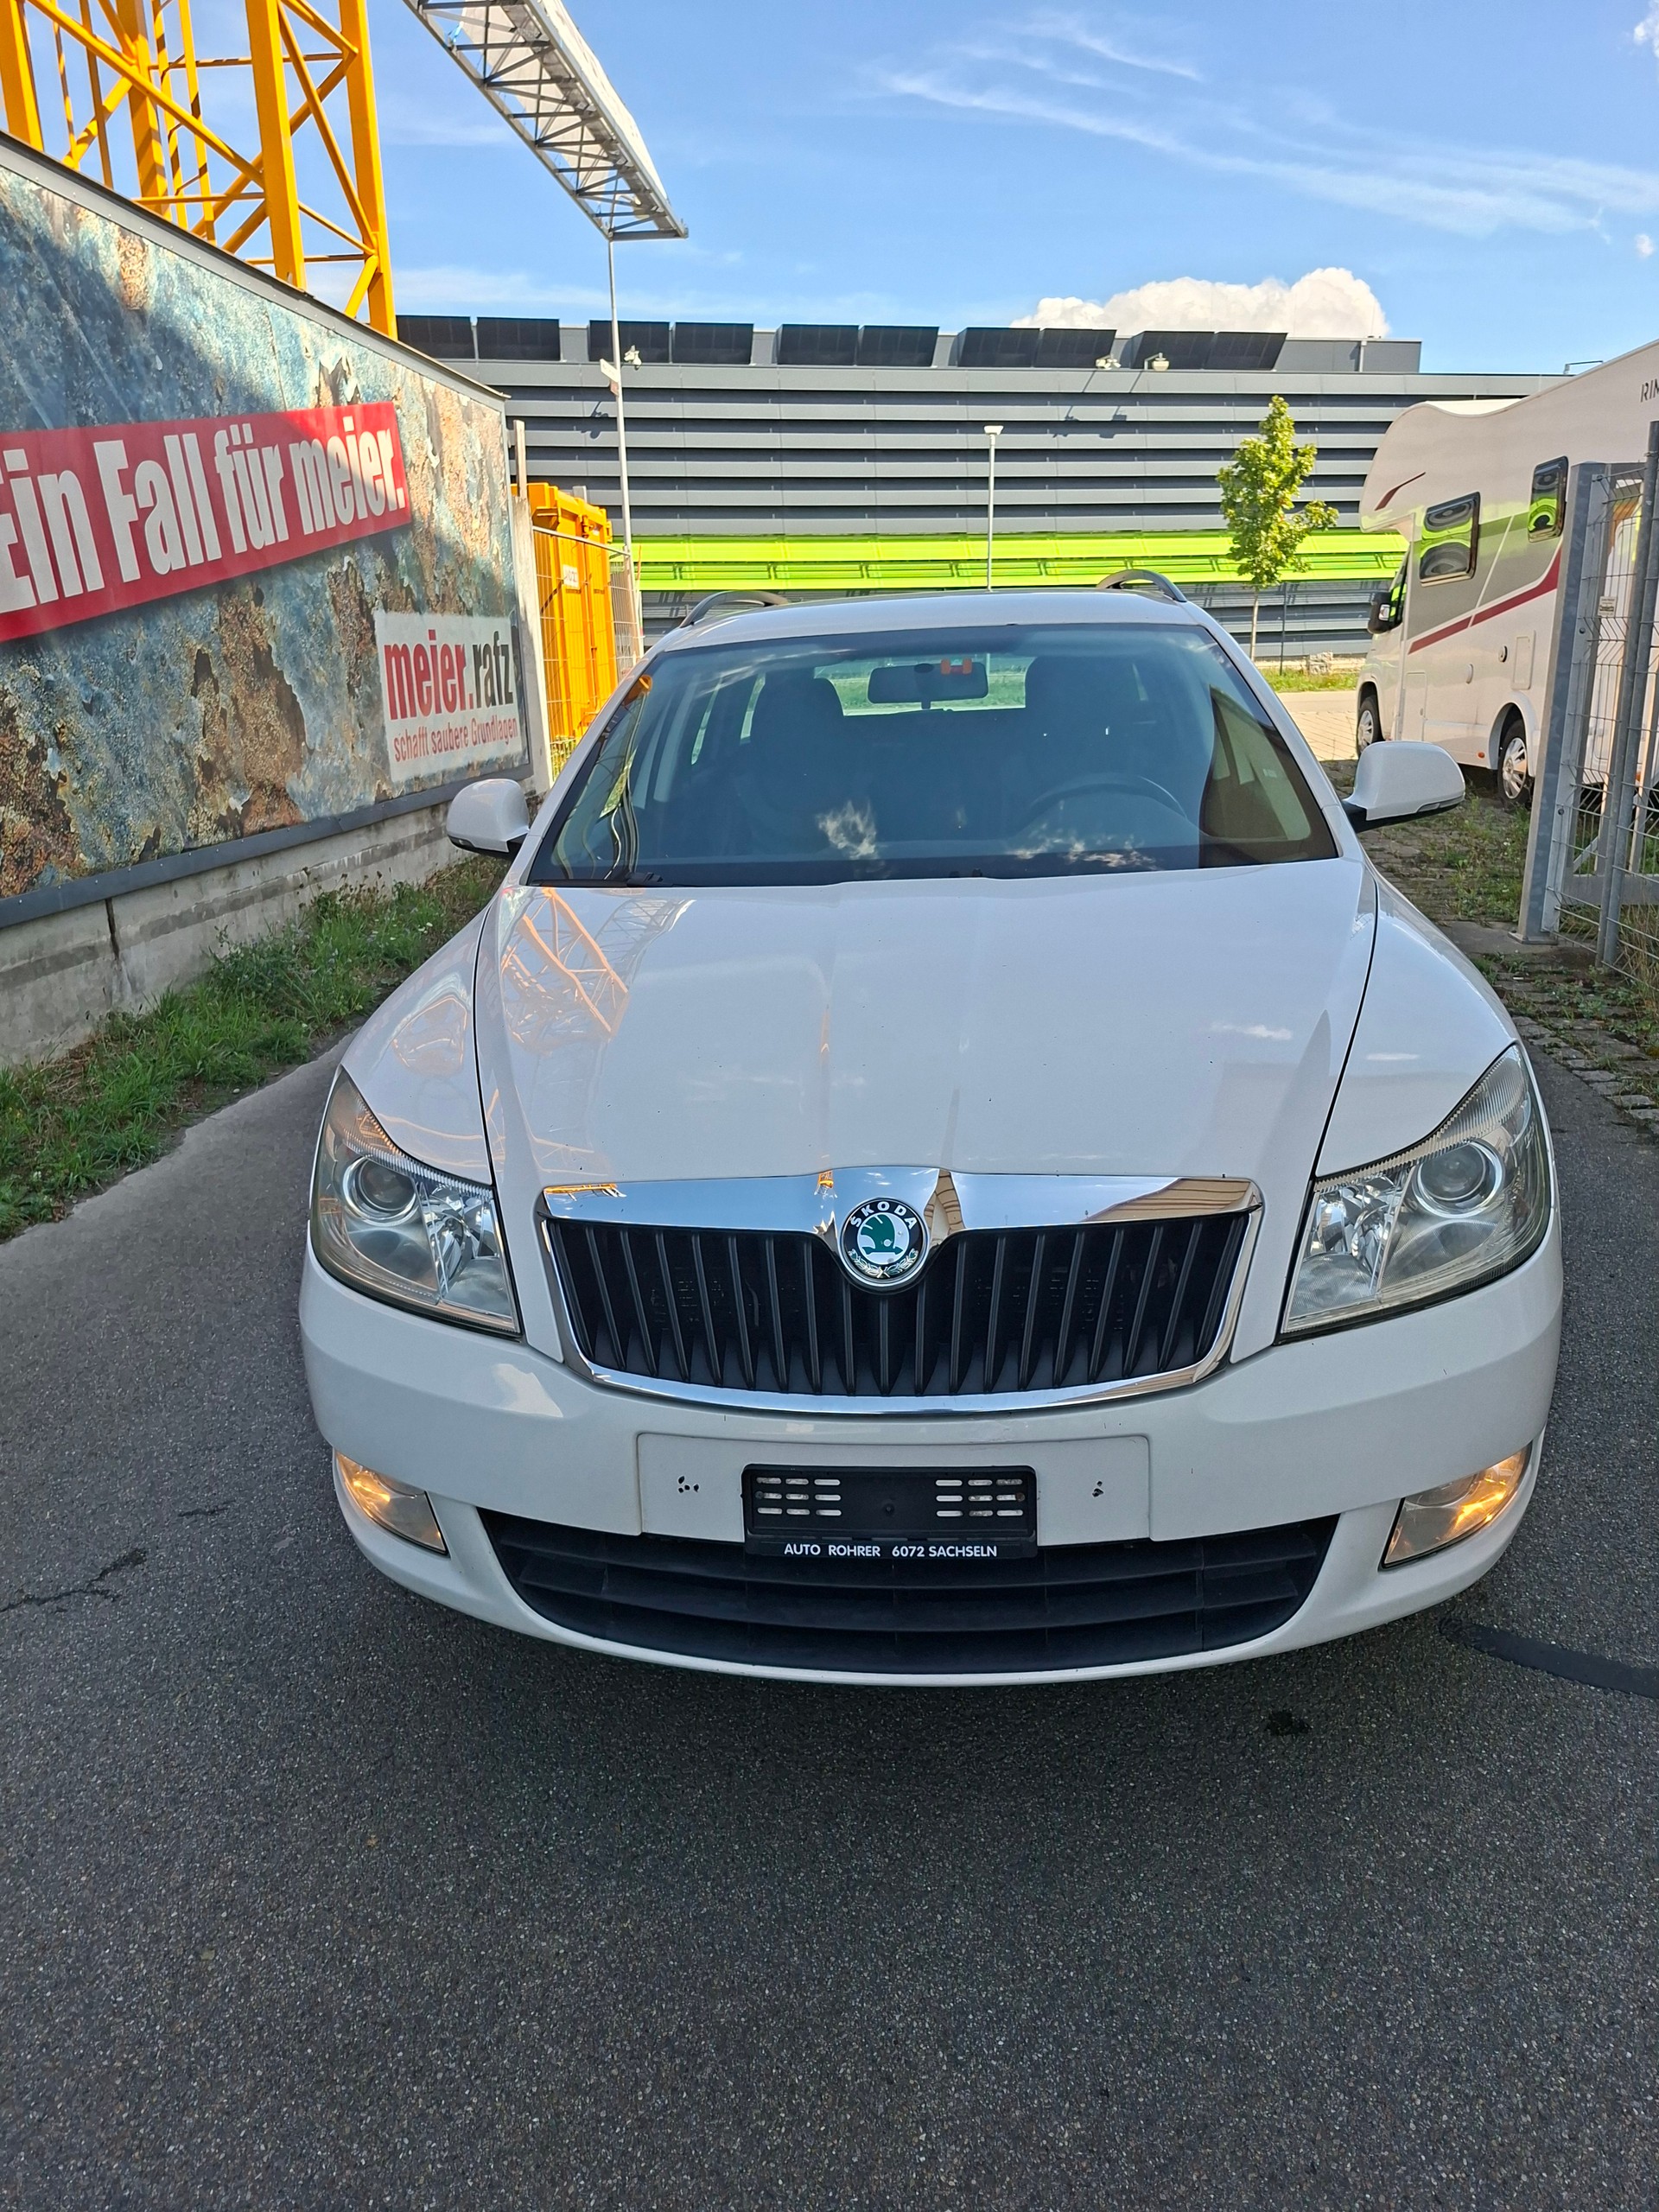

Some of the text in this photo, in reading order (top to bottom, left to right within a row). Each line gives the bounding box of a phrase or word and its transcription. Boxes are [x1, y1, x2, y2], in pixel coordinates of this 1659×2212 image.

[93, 433, 222, 583] Fall
[214, 423, 289, 554] für
[289, 416, 405, 535] meier.
[384, 629, 514, 720] meier.rafz
[394, 715, 518, 762] schafft saubere Grundlagen
[784, 1543, 997, 1557] AUTO ROHRER 6072 SACHSELN
